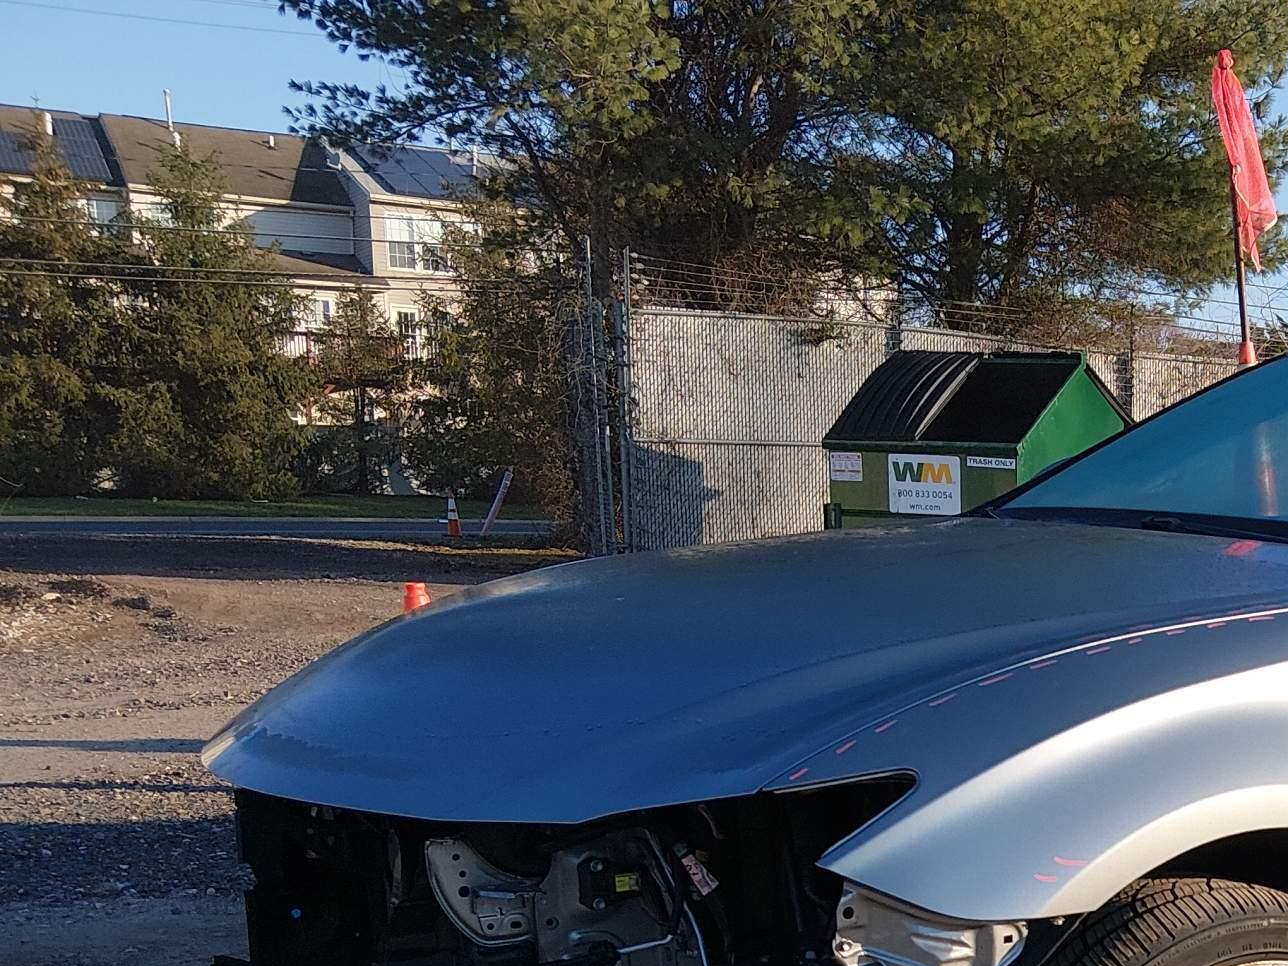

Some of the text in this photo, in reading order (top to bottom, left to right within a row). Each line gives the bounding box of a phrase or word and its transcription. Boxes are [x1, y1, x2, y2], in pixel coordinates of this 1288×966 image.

[968, 457, 1015, 468] TRASH ONLY
[892, 461, 953, 484] WM
[897, 489, 953, 500] 800 833 0054
[909, 503, 941, 512] wm.com
